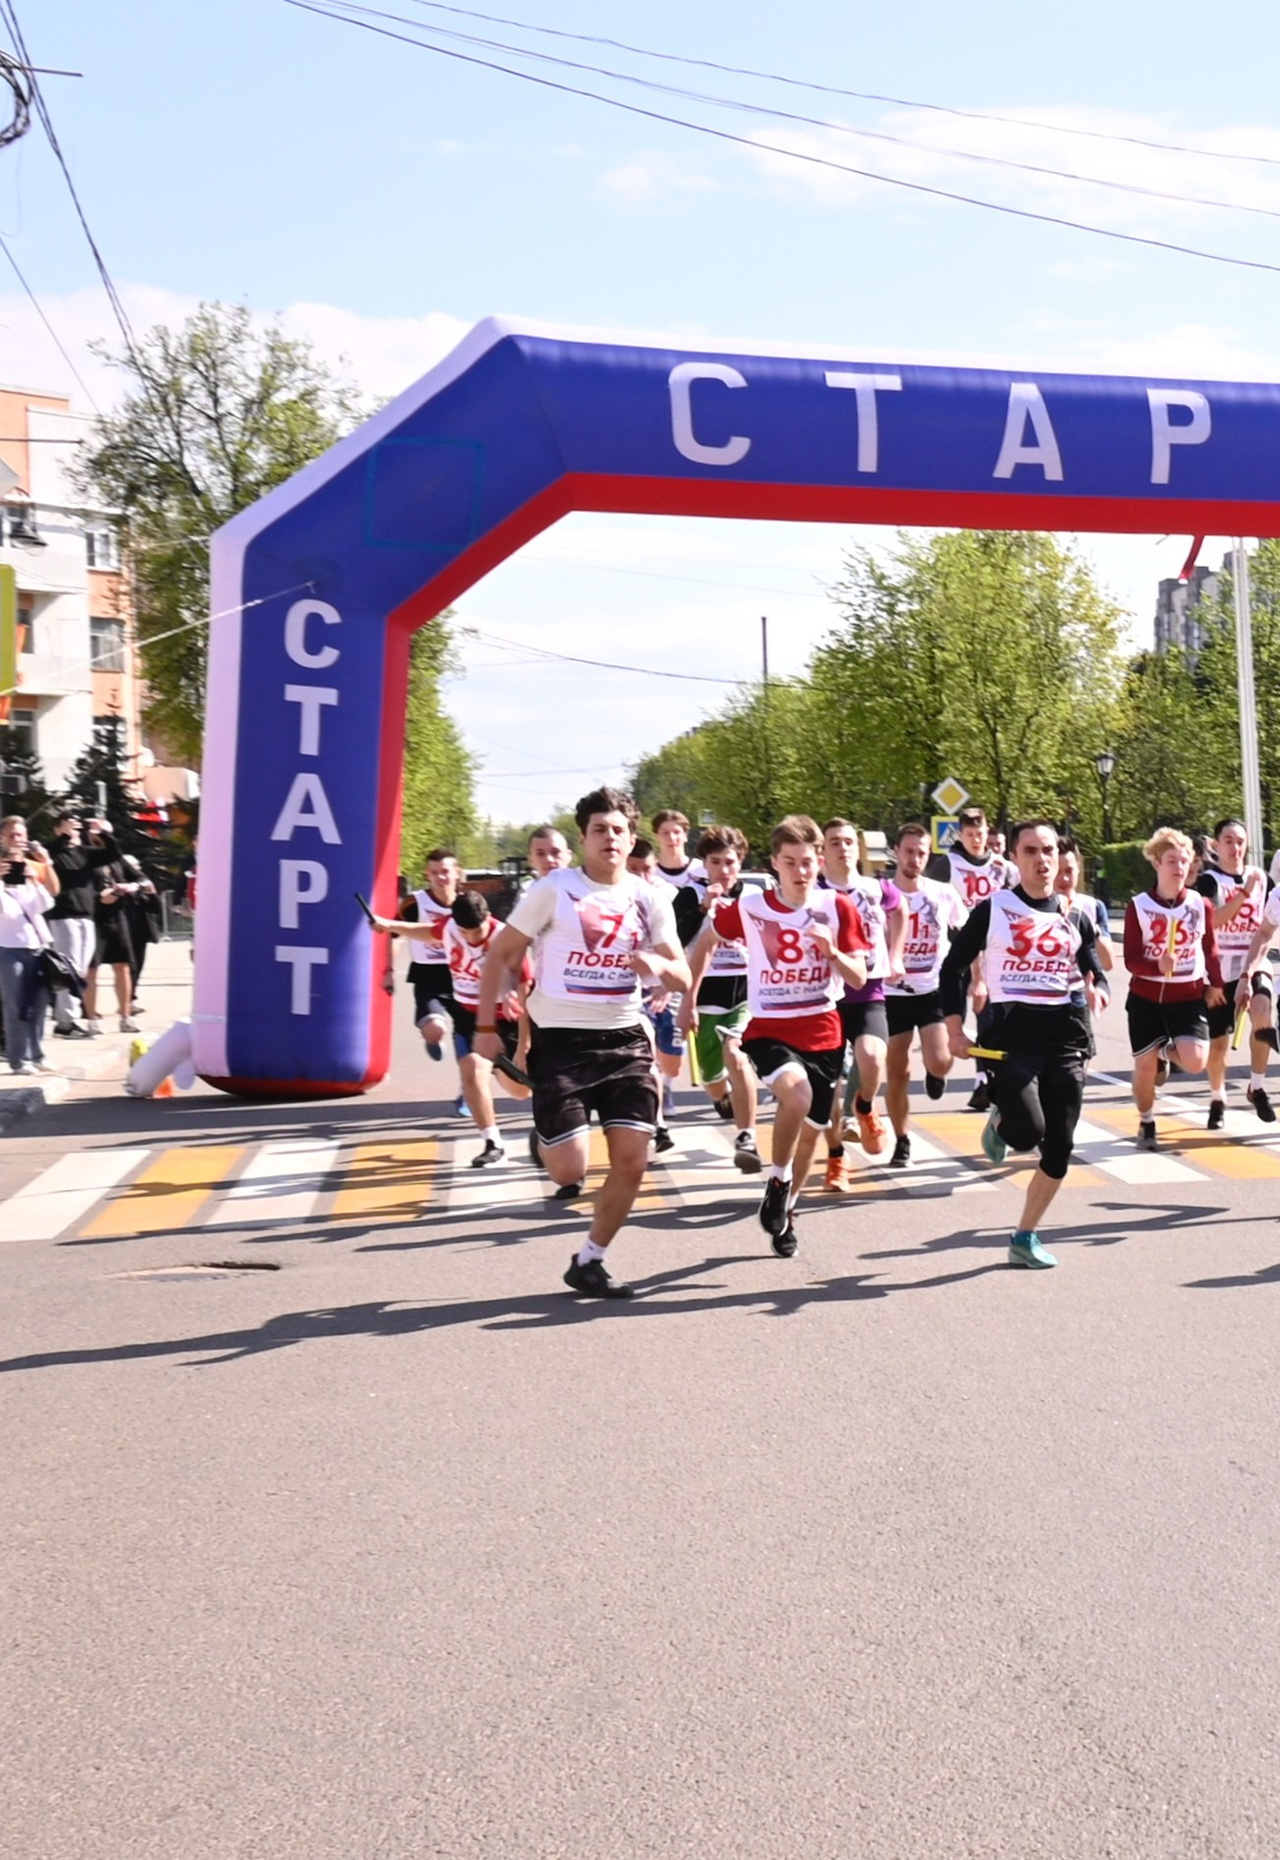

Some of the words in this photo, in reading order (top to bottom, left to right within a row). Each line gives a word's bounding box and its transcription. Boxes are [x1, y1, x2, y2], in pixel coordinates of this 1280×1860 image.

[269, 598, 343, 1016] СТАРТ
[599, 914, 624, 949] 7
[776, 929, 804, 964] 8
[1006, 922, 1062, 957] 36
[563, 967, 605, 981] ВСЕГДА
[567, 950, 632, 971] ПОБЕ
[1003, 960, 1071, 975] ПОБЕД
